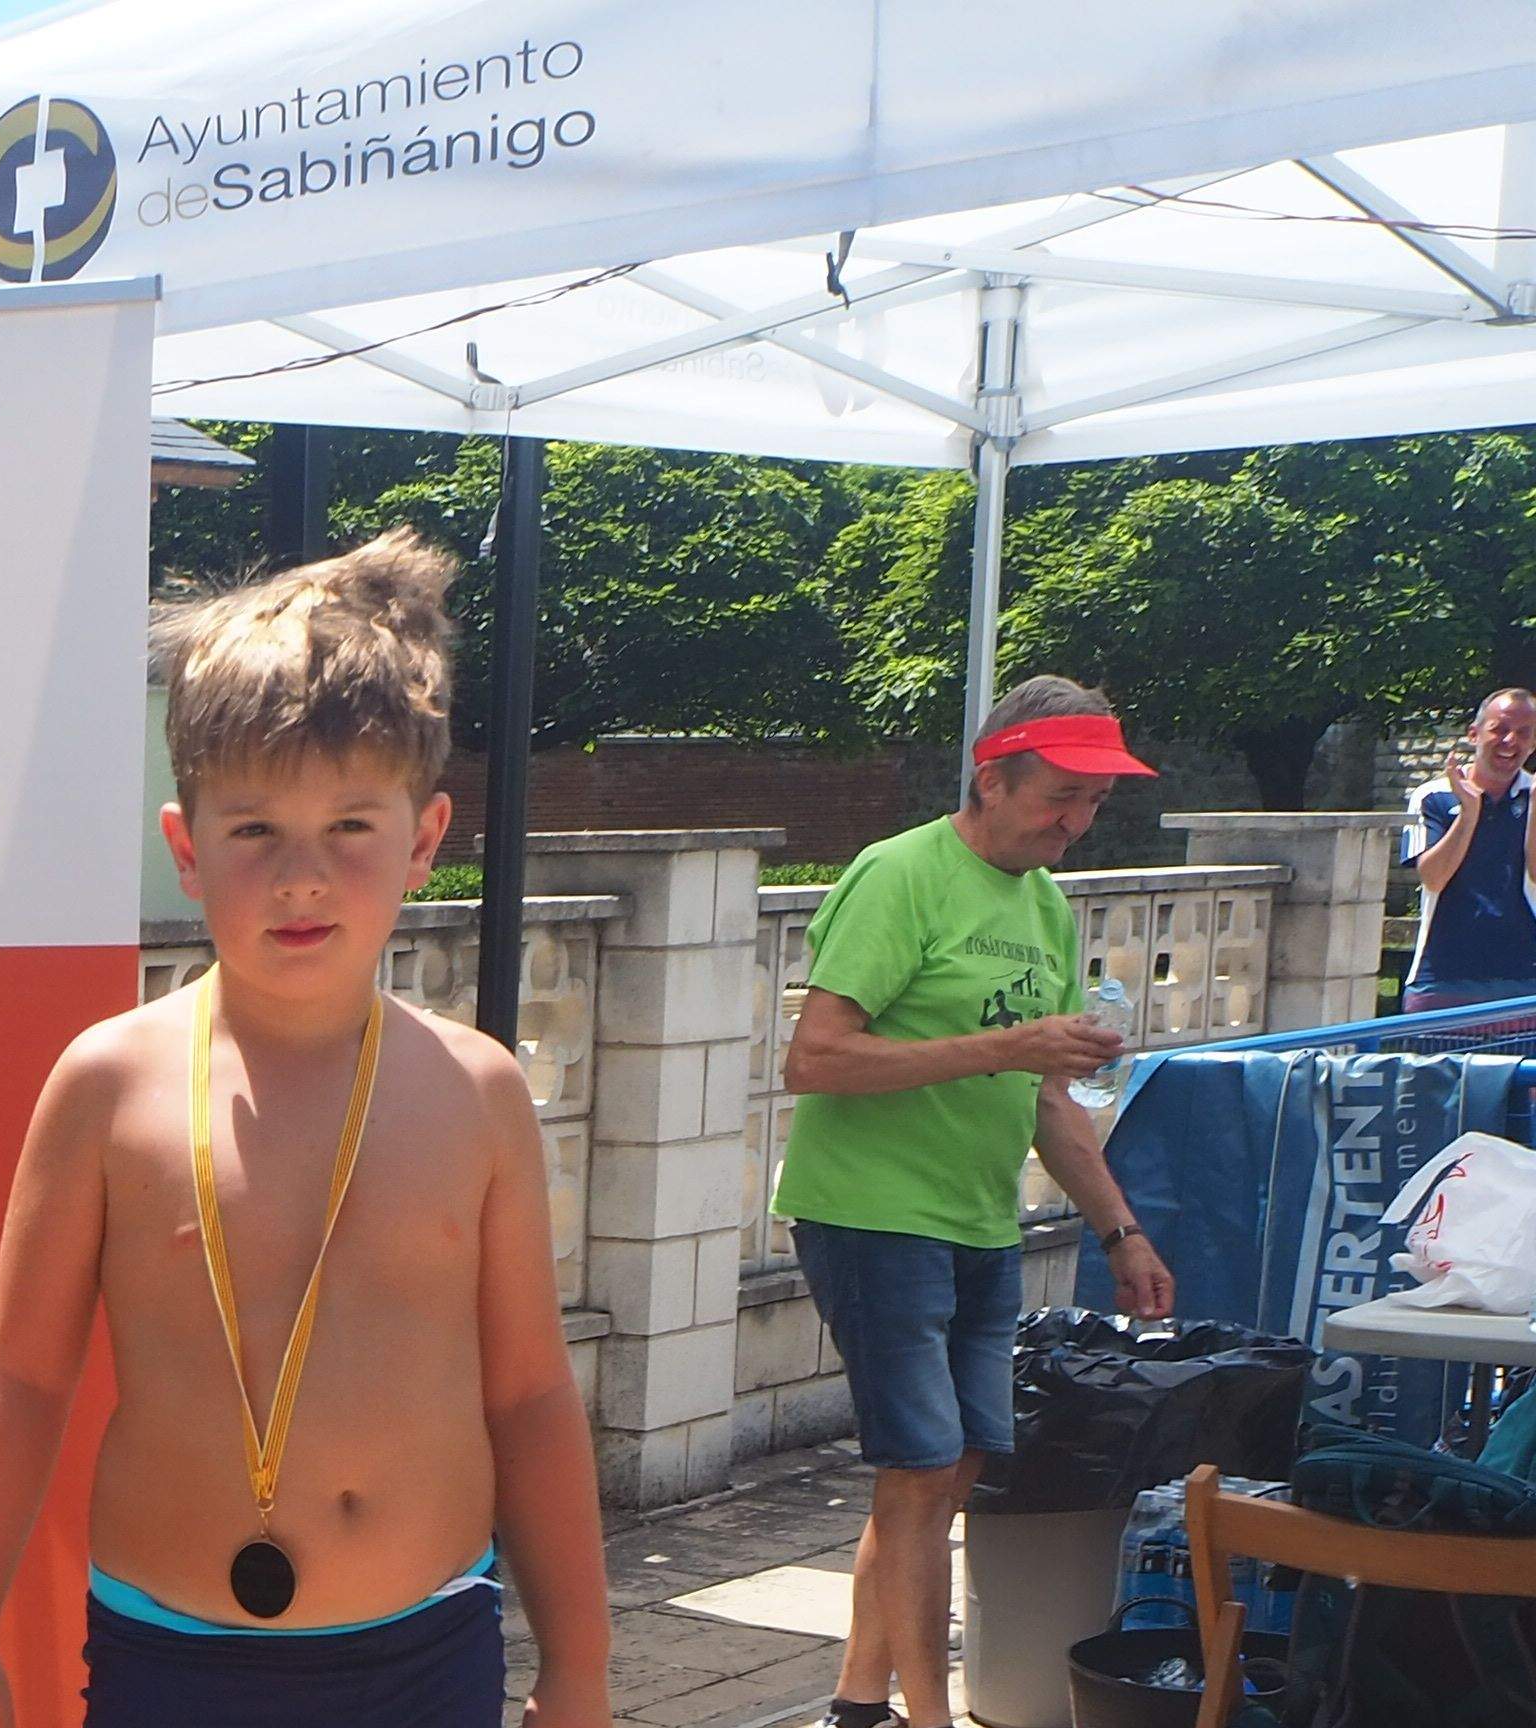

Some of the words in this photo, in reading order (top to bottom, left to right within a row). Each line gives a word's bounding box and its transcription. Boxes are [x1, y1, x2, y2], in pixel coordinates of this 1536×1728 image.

[136, 39, 584, 166] Ayuntamiento
[136, 109, 597, 229] deSabiñánigo
[1310, 1058, 1384, 1426] ASTERTENT
